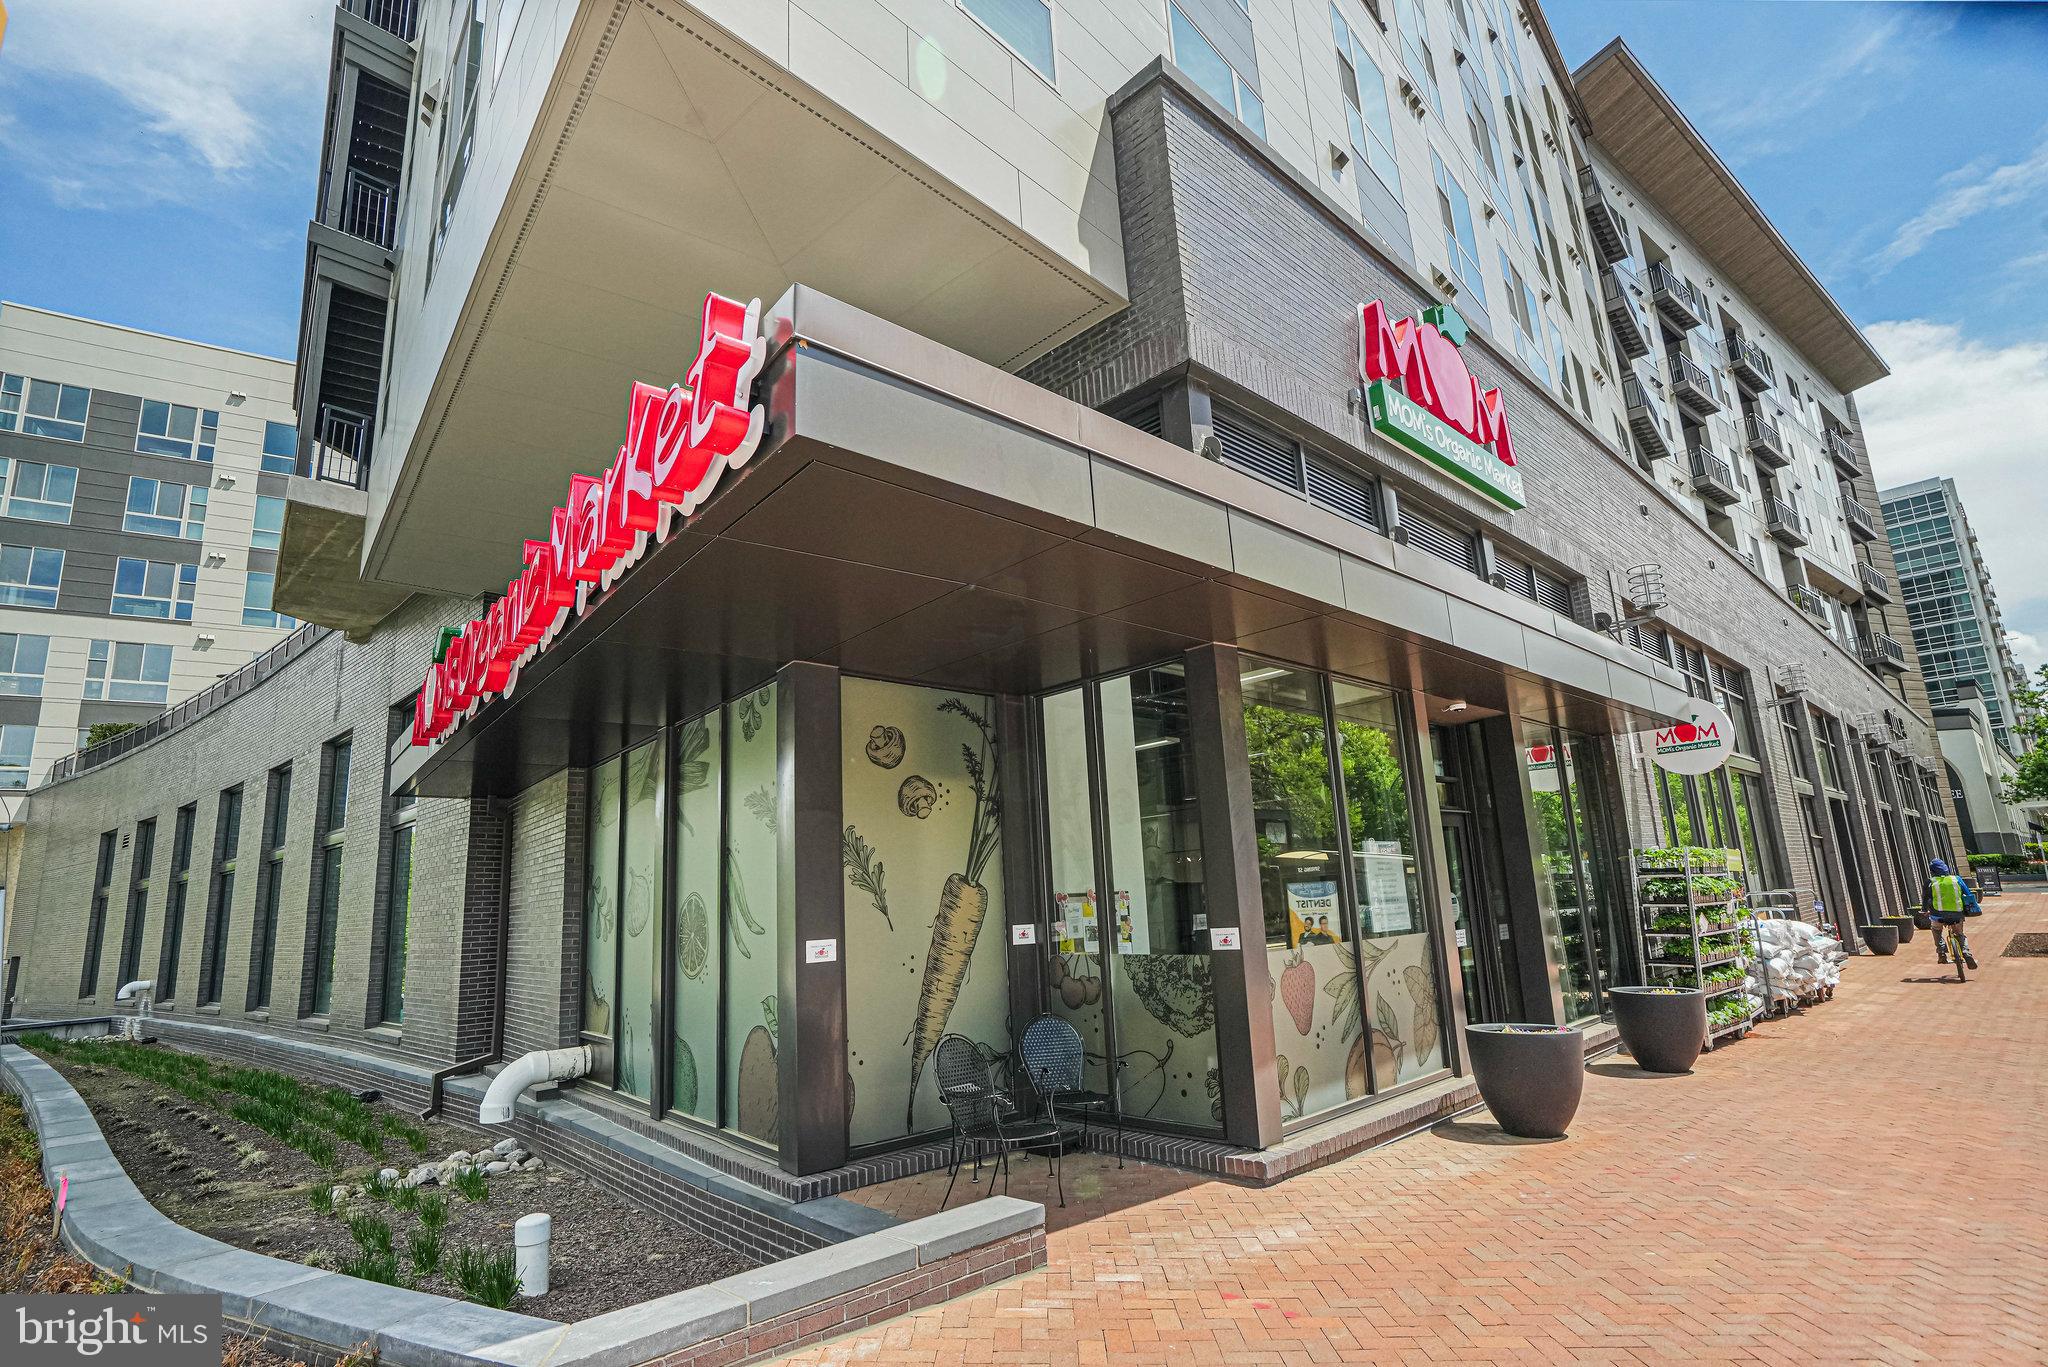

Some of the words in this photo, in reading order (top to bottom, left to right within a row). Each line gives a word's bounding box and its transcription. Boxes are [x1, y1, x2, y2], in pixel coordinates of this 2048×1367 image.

[546, 291, 754, 610] Market
[1388, 394, 1434, 441] MOM's
[1434, 425, 1483, 471] Organic
[1483, 455, 1525, 497] Market
[1656, 721, 1719, 746] MOM
[1675, 743, 1697, 752] Organic
[1697, 740, 1720, 749] Market
